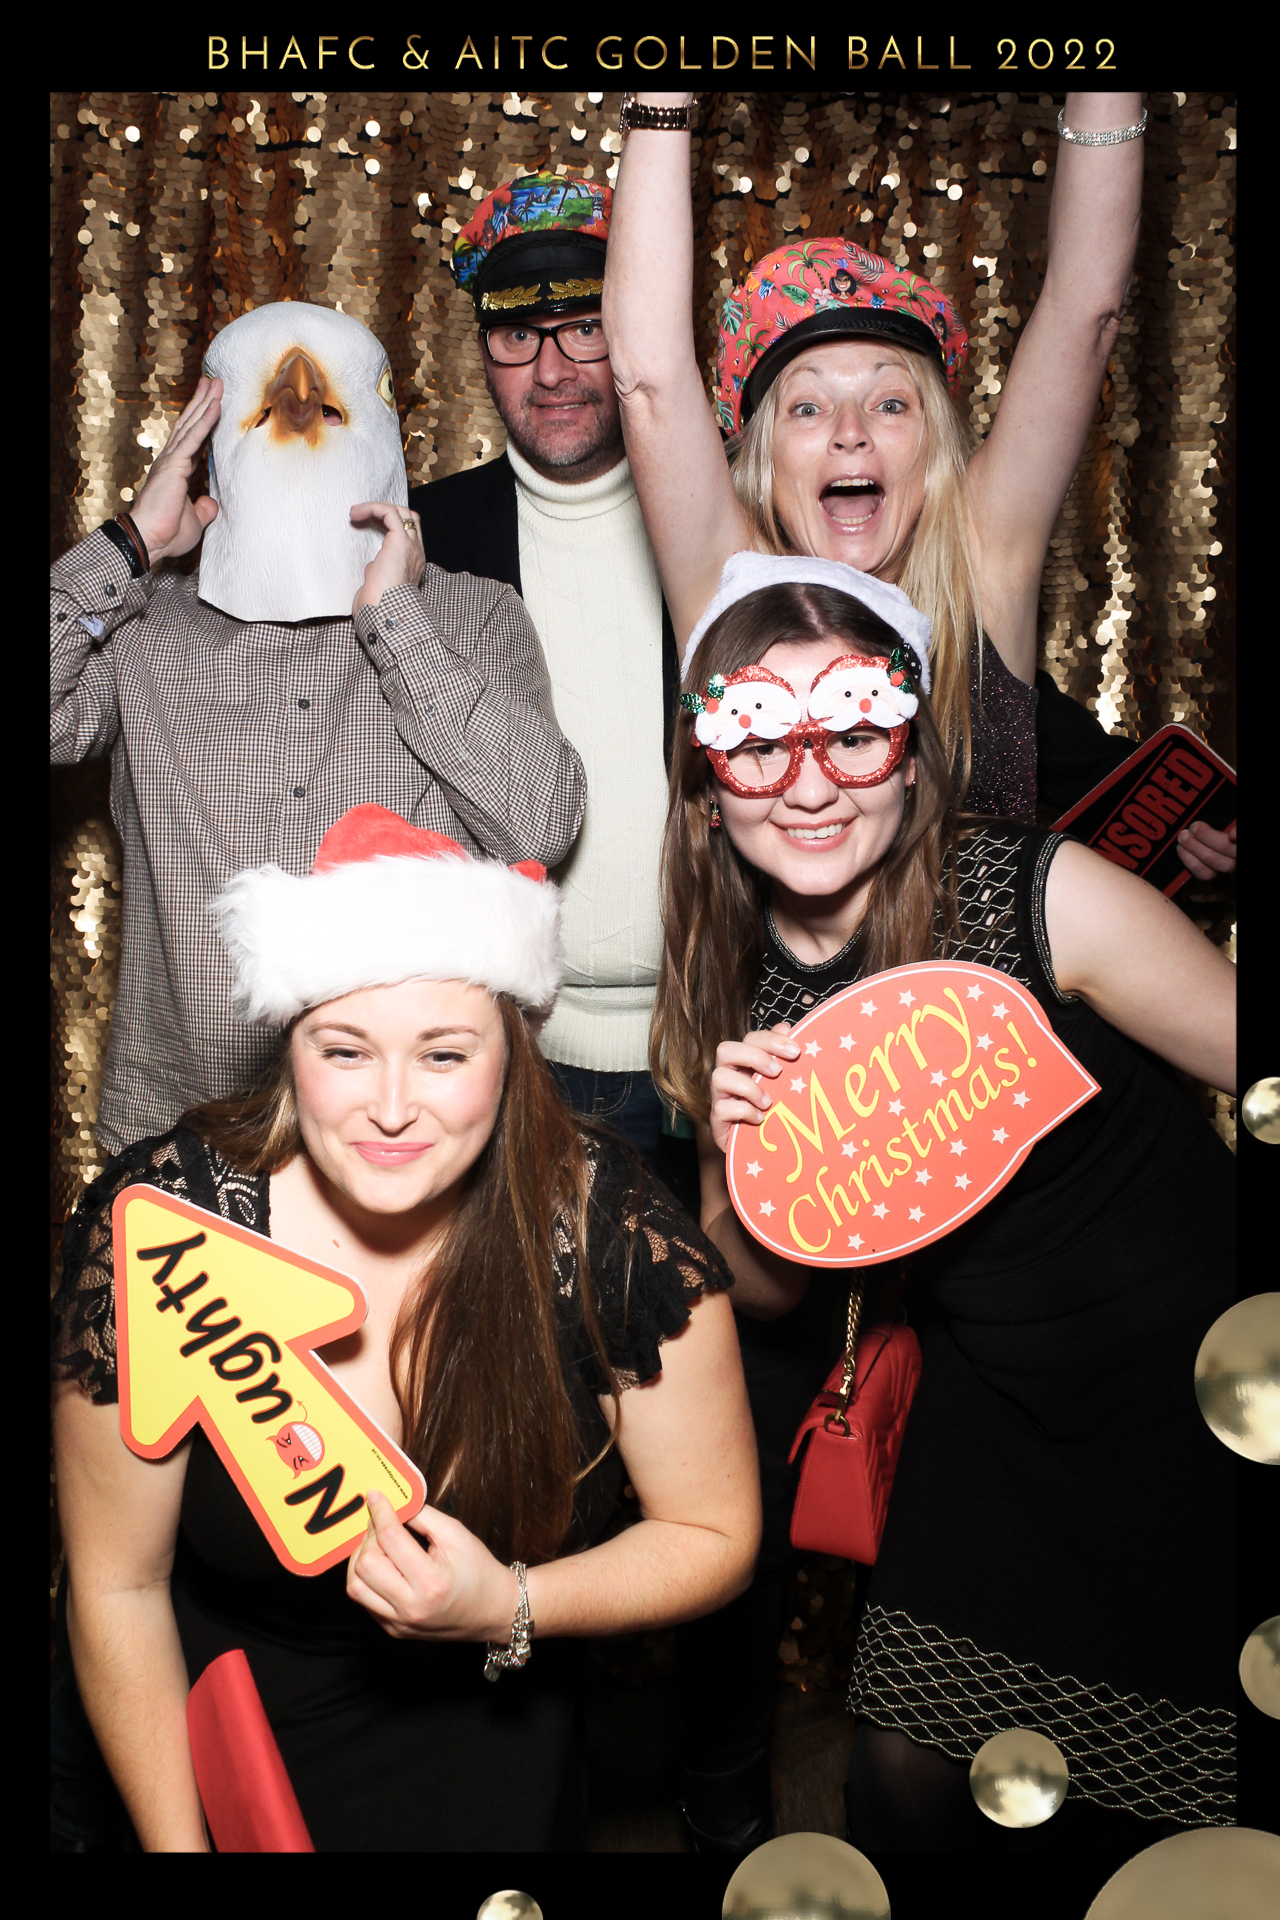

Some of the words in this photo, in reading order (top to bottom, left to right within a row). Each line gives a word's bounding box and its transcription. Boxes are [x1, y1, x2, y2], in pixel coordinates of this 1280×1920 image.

[758, 987, 972, 1183] Merry
[787, 1021, 1038, 1253] Christmas!
[136, 1231, 367, 1535] Nughty
